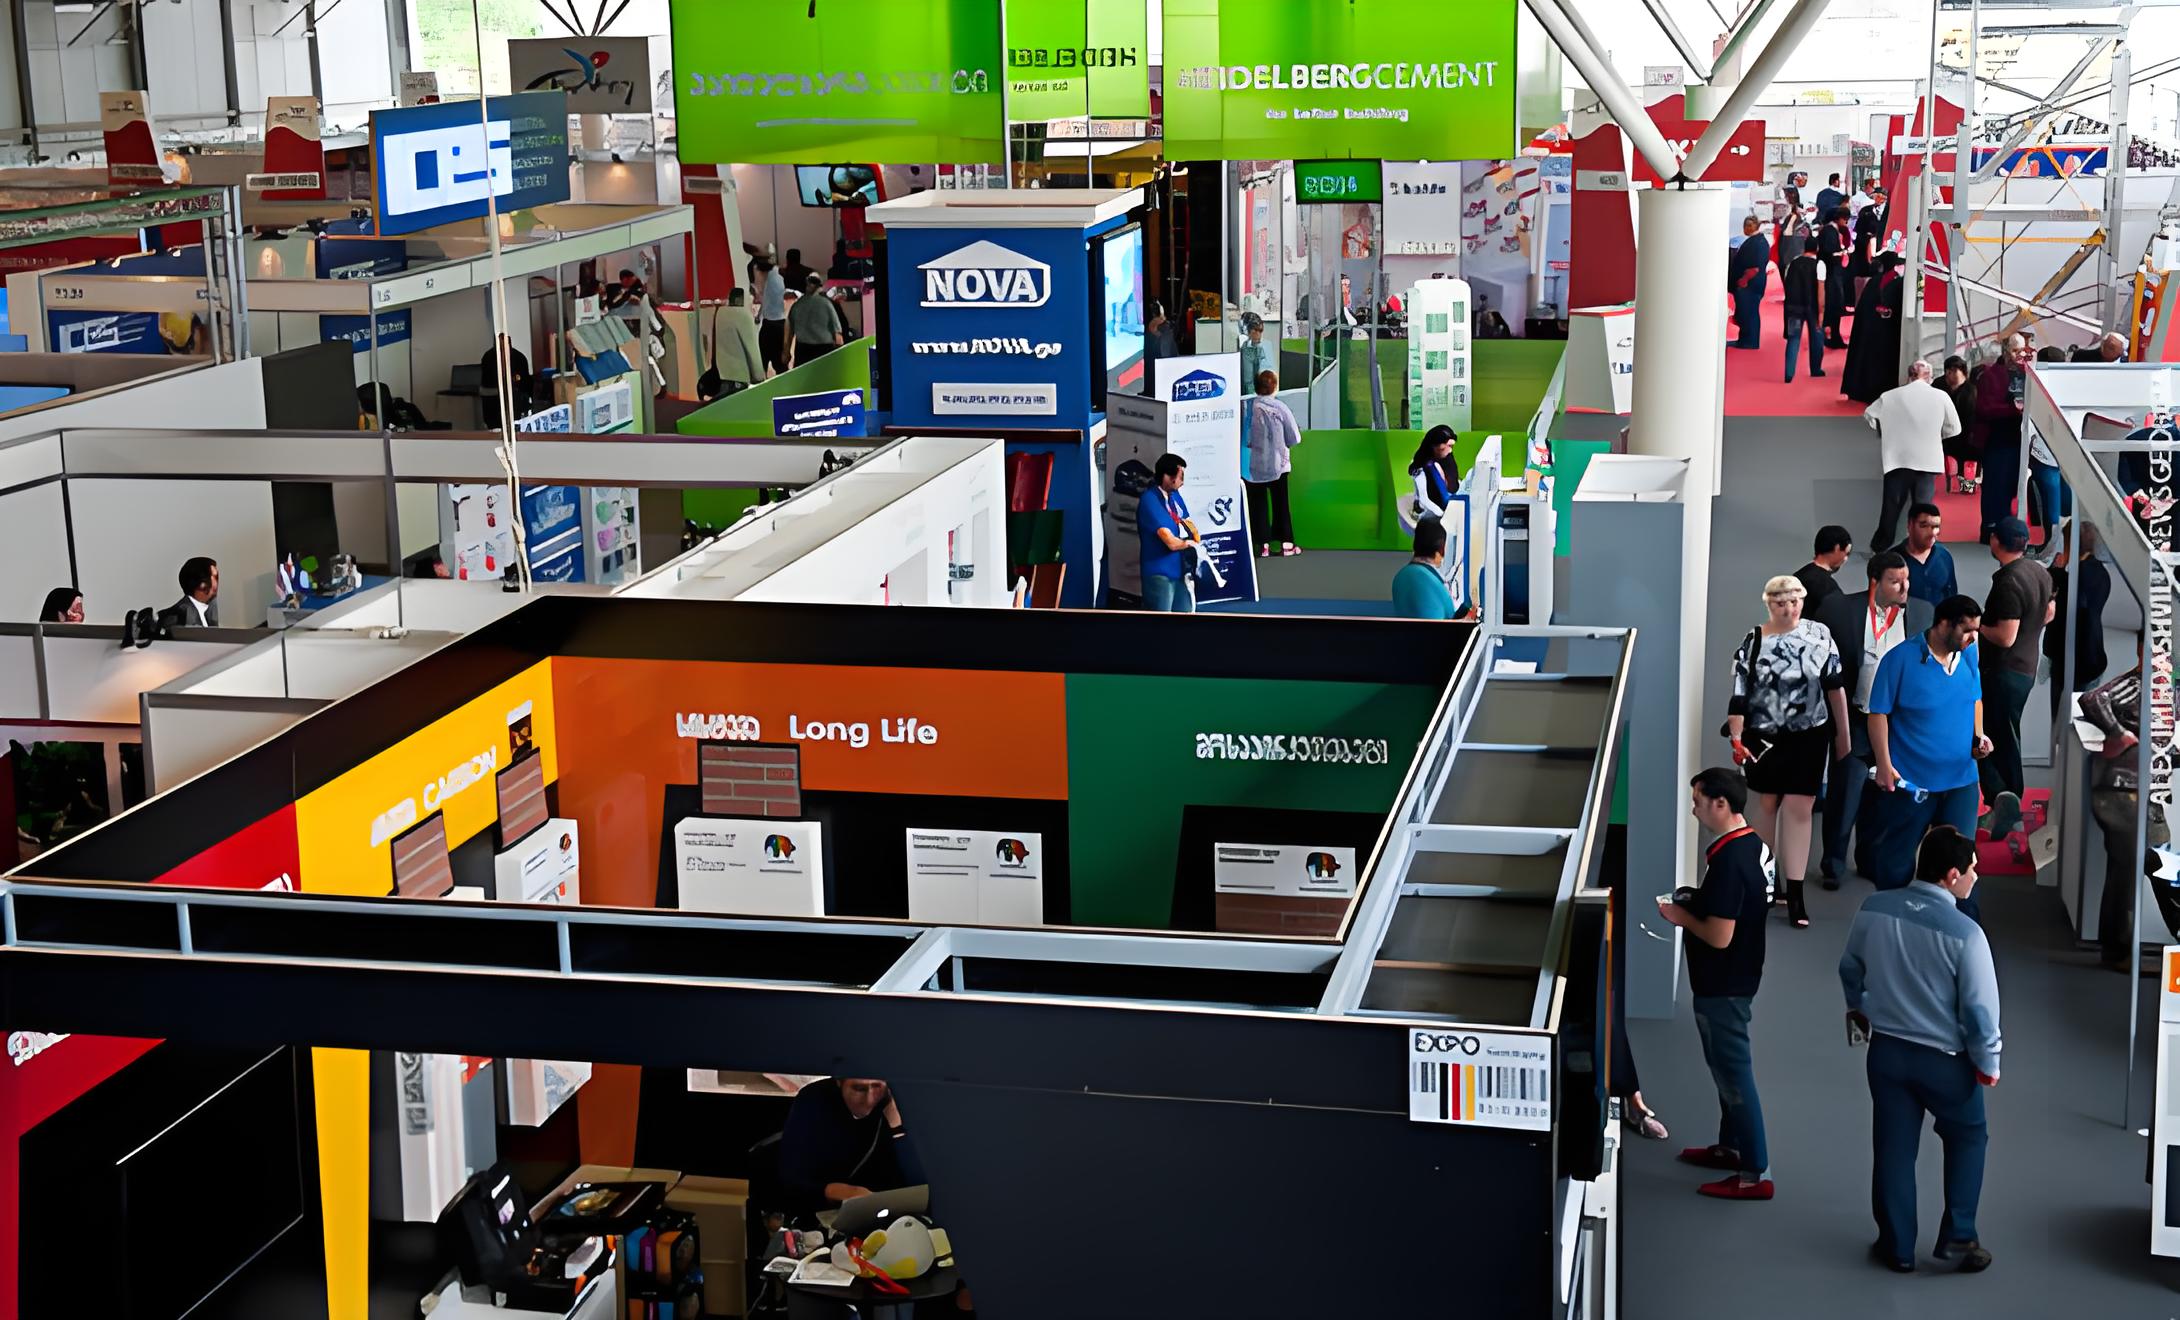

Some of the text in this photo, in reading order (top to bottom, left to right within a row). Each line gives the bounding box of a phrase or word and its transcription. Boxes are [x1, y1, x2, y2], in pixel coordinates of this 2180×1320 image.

[926, 269, 1038, 302] NOVA
[789, 714, 870, 749] Long
[880, 717, 939, 746] Life
